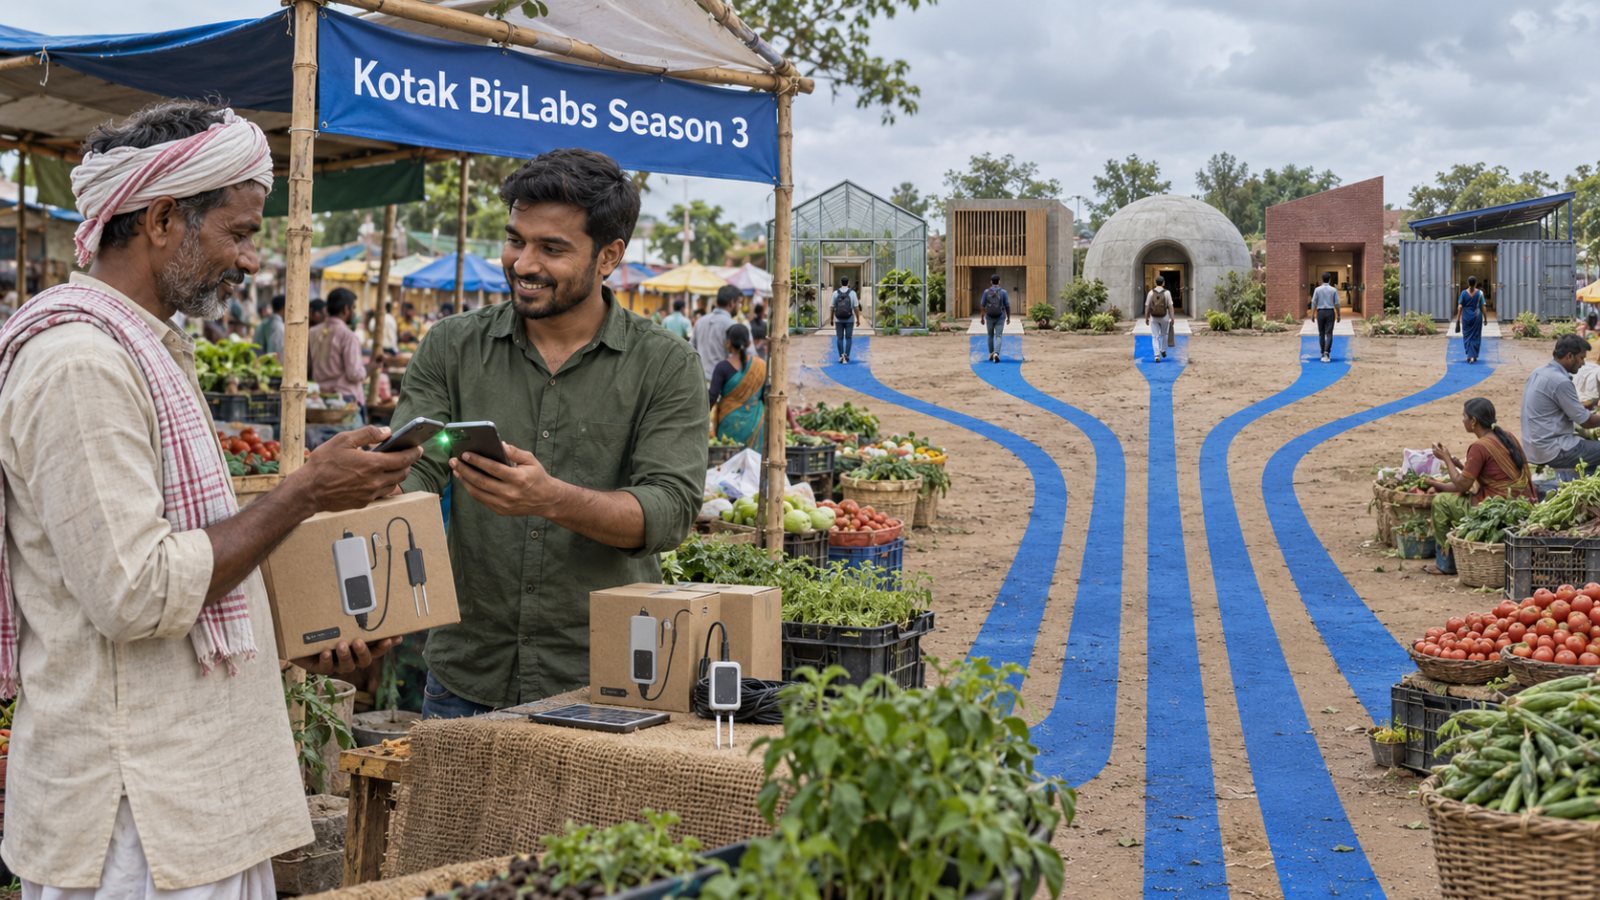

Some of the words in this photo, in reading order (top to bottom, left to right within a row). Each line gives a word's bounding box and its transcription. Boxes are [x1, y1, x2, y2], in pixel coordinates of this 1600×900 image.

[354, 57, 460, 110] Kotak
[470, 77, 598, 129] BizLabs
[608, 99, 723, 145] Season
[732, 117, 749, 148] 3
